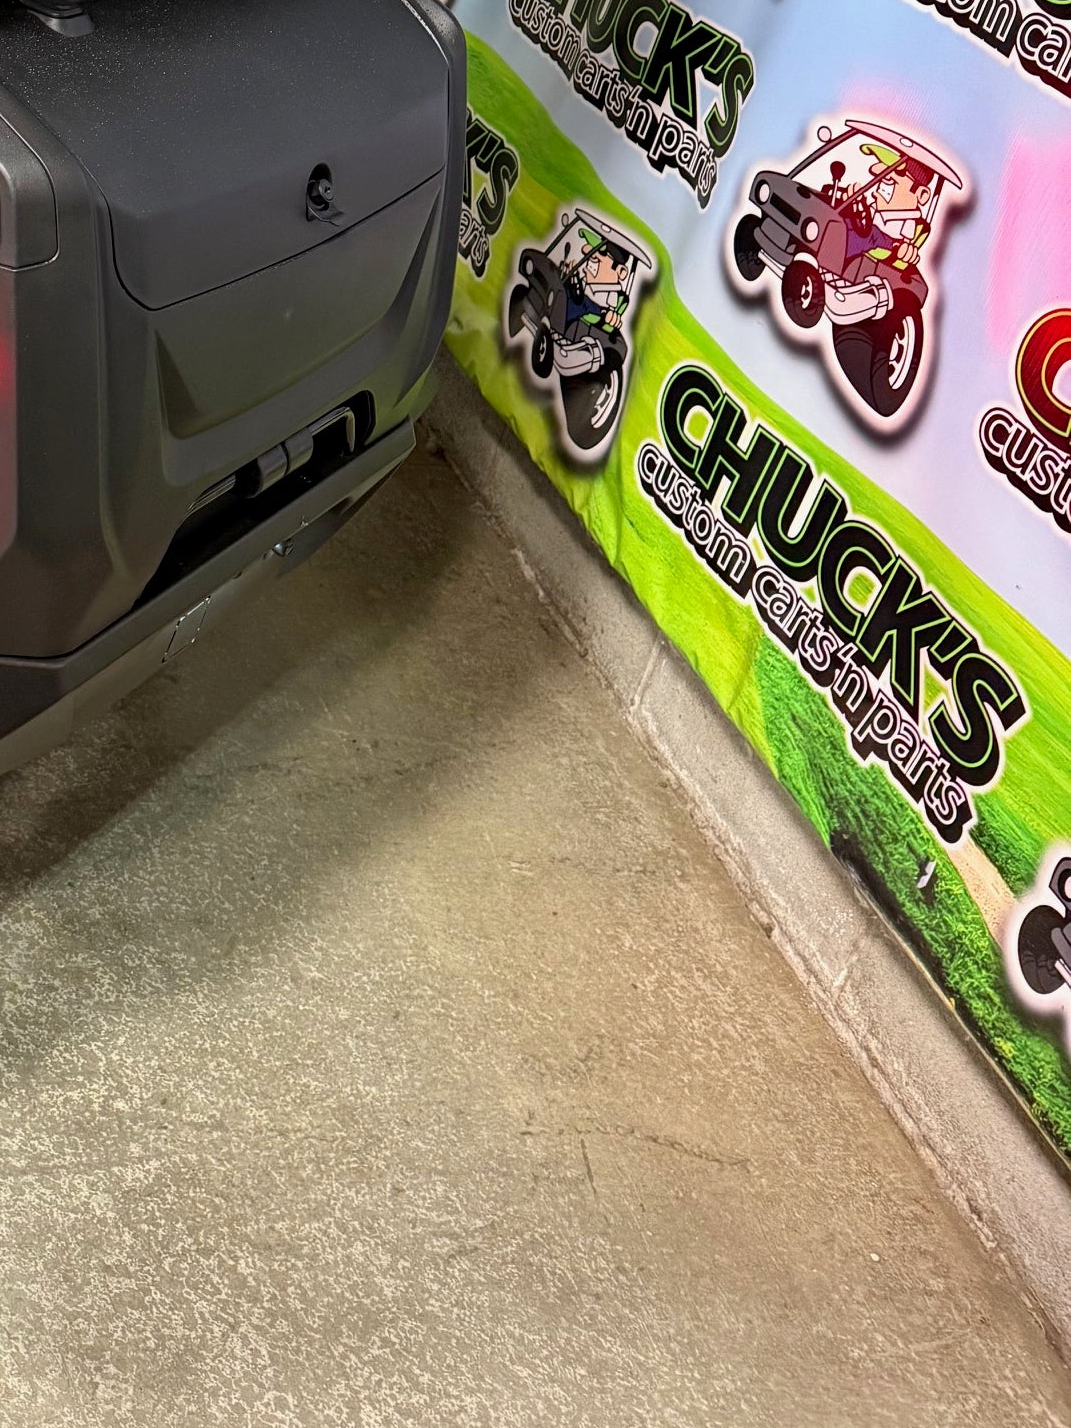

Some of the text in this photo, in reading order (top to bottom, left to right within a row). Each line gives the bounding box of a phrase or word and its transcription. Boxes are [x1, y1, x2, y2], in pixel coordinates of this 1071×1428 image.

[646, 112, 718, 209] parts
[637, 443, 756, 598] custom
[851, 690, 974, 843] parts
[660, 365, 1026, 789] CHUCK'S
